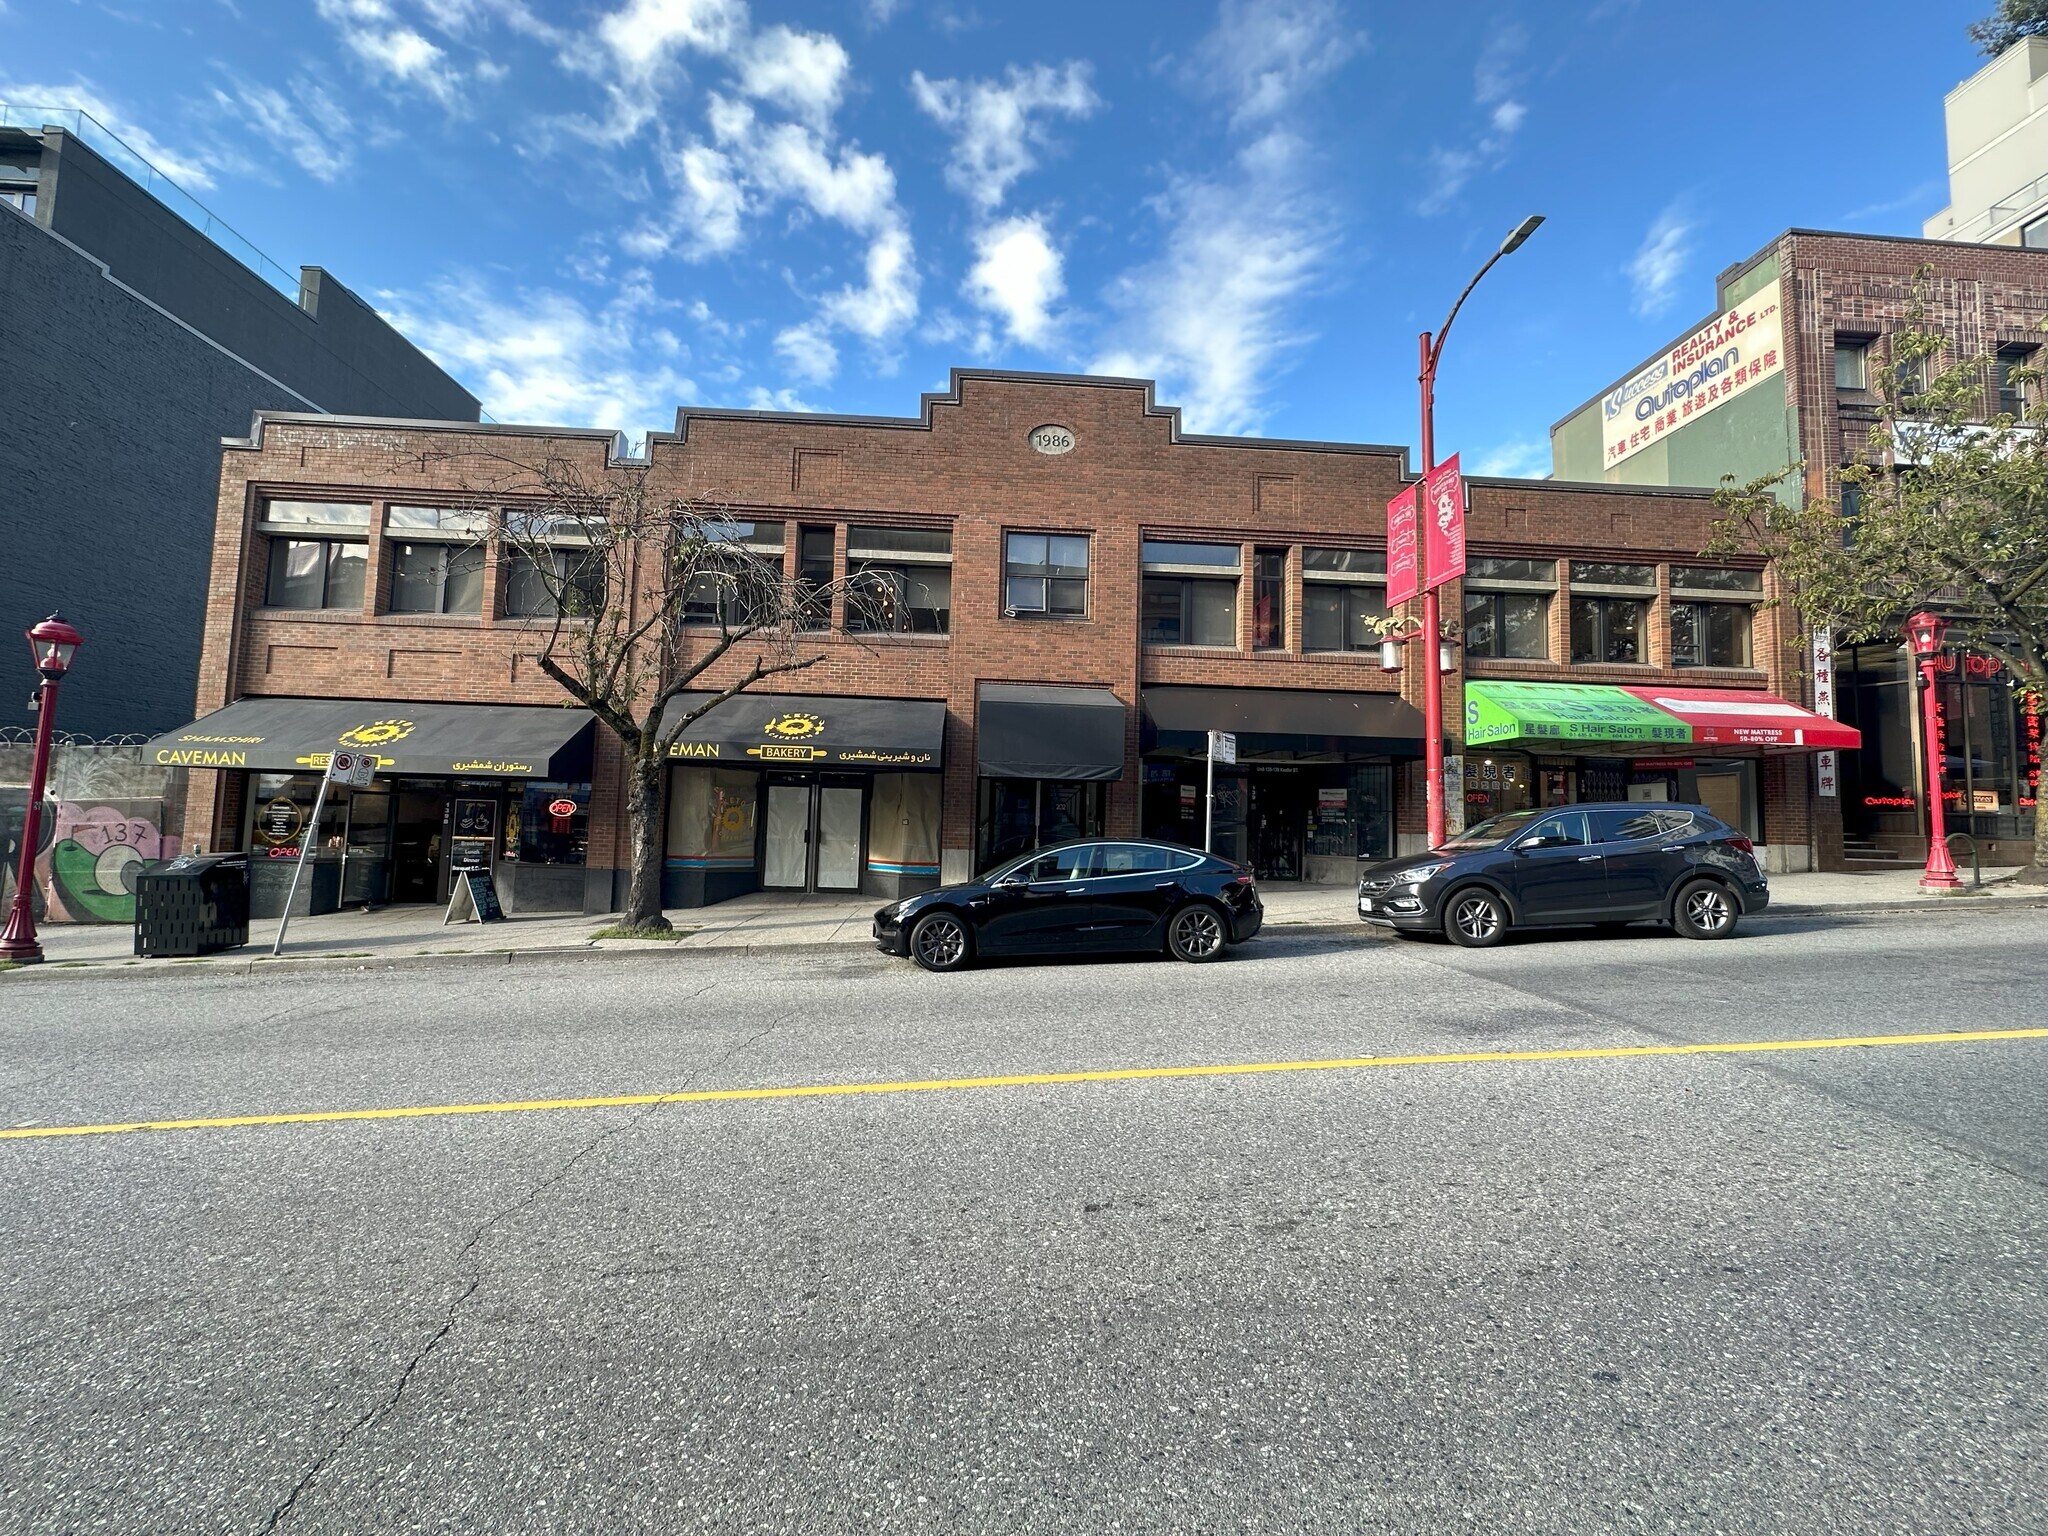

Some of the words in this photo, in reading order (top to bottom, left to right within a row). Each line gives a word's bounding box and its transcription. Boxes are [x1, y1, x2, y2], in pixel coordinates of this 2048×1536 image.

[1672, 319, 1722, 364] REALTY
[1728, 310, 1740, 325] &
[1672, 312, 1757, 376] INSURANCE
[1759, 304, 1779, 320] LTD.
[1635, 346, 1740, 422] autoplan
[1606, 363, 1667, 422] Success
[1035, 434, 1070, 448] 1986
[1467, 700, 1479, 725] S
[1555, 712, 1587, 721] Hair
[1589, 713, 1638, 722] Salon
[1468, 727, 1485, 741] Hair
[1487, 722, 1516, 737] Salon
[1569, 723, 1578, 732] S
[1581, 724, 1604, 733] Hair
[1608, 725, 1642, 735] Salon
[1734, 728, 1750, 736] NEW
[177, 734, 266, 744] SHAMSHIRI
[156, 749, 247, 766] CAVEMAN
[766, 747, 808, 758] BAKERY
[916, 753, 931, 763] نان
[1466, 793, 1490, 803] OPEN
[551, 803, 574, 813] OPEN
[101, 823, 148, 845] 137
[269, 847, 301, 858] OPEN
